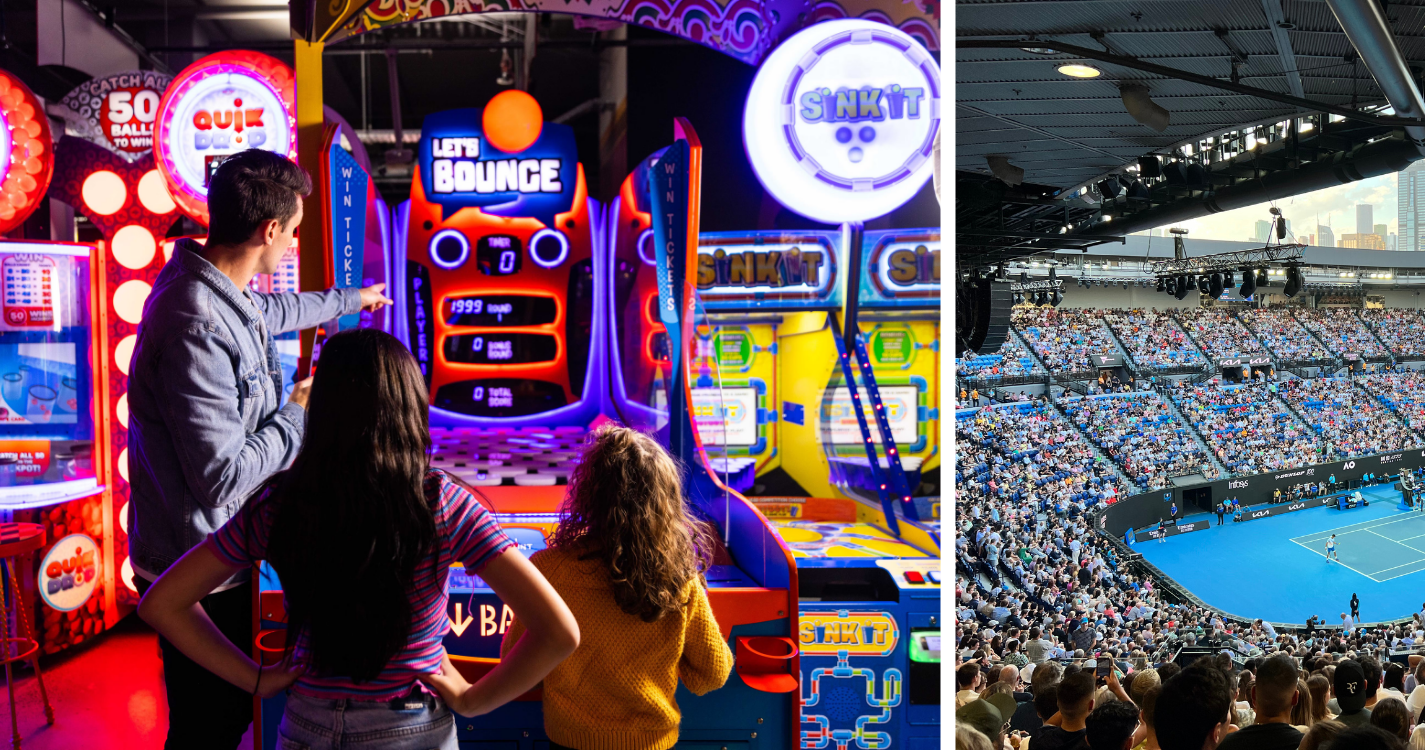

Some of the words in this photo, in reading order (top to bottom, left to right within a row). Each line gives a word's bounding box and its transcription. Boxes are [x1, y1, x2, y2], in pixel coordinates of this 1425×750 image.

[90, 75, 140, 96] CATCH
[108, 90, 160, 123] 50
[114, 137, 129, 148] TO
[432, 137, 480, 158] LET'S
[433, 158, 562, 193] BOUNCE
[665, 163, 675, 203] WIN
[342, 167, 352, 207] WIN
[344, 217, 352, 286] TICKE
[666, 213, 675, 311] TICKETS
[451, 299, 484, 314] 1999
[413, 277, 428, 362] PLAYER
[472, 337, 484, 352] 0
[473, 387, 484, 401] 0
[1343, 461, 1356, 470] AO
[1228, 480, 1249, 489] Infosys
[1252, 510, 1270, 518] KIA
